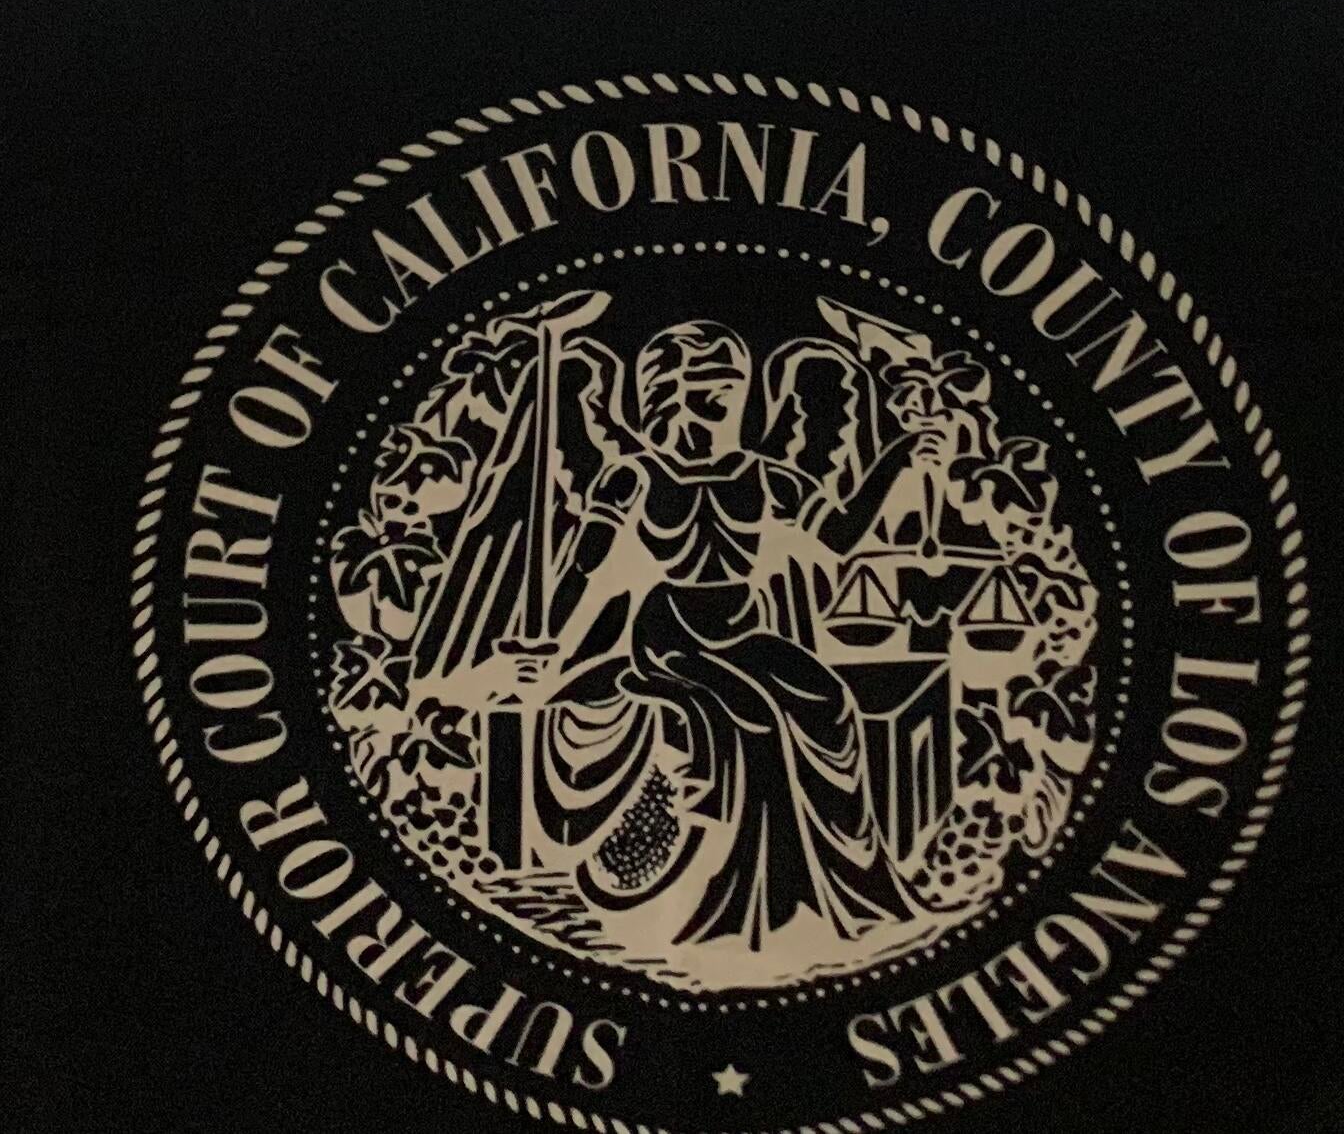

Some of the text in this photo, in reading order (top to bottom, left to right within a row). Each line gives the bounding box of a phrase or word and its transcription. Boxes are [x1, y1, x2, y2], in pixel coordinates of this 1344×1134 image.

[184, 121, 1262, 1090] SUPERIOR COURT OF CALIFORNIA, COUNTY OF LOS ANGELES
